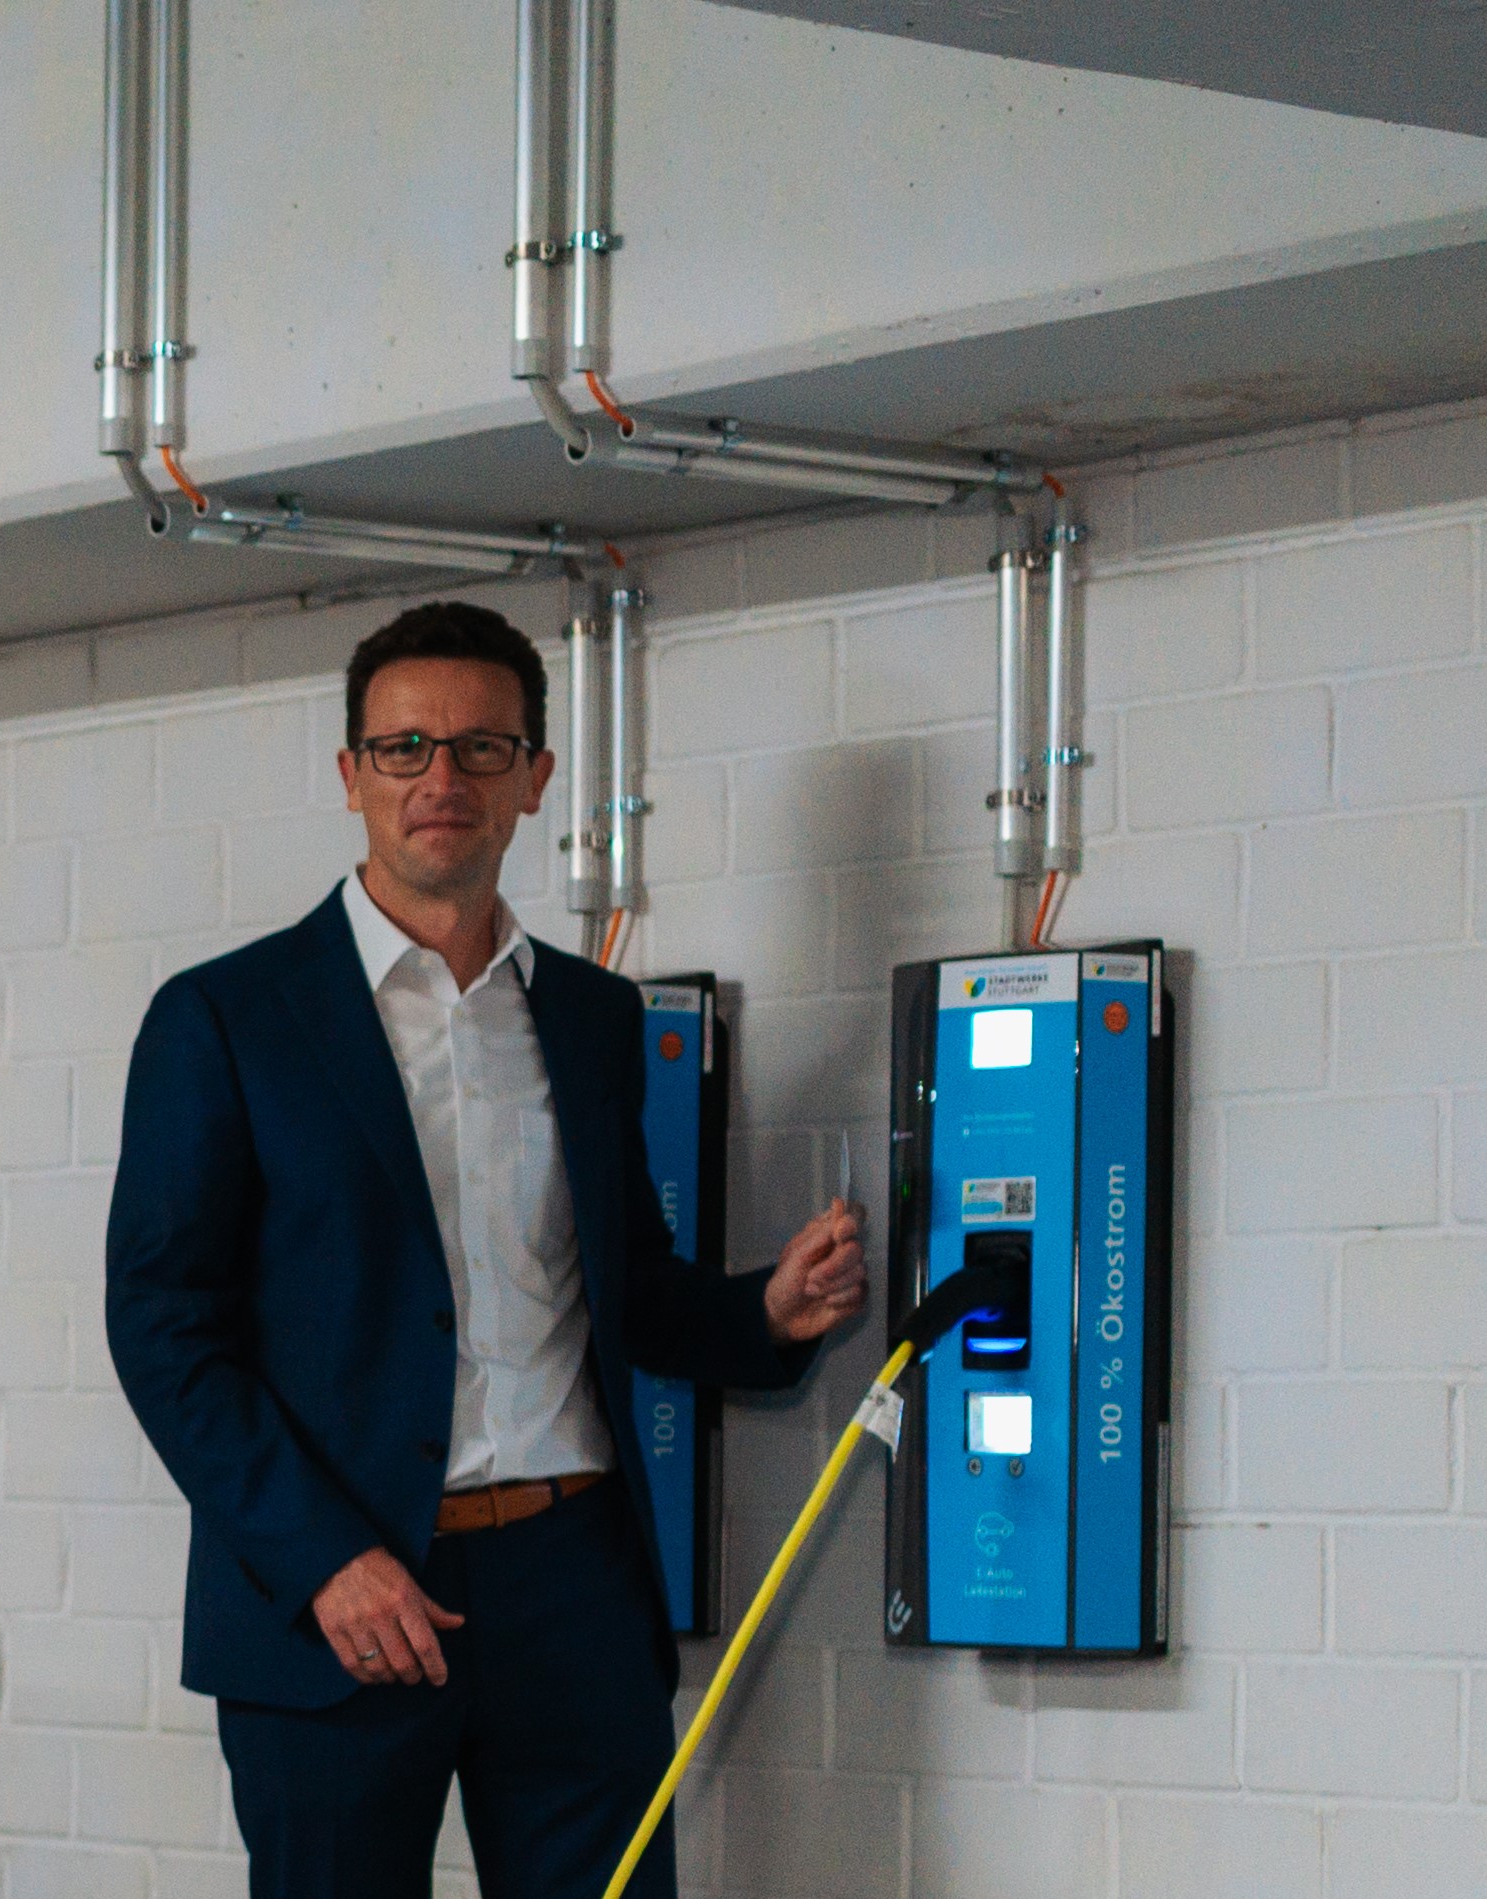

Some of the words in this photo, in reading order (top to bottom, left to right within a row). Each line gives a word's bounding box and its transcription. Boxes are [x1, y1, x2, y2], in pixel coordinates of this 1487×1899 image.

[1096, 1164, 1126, 1343] Ökostrom
[1100, 1357, 1124, 1390] %
[653, 1402, 676, 1459] 100
[1099, 1403, 1123, 1464] 100
